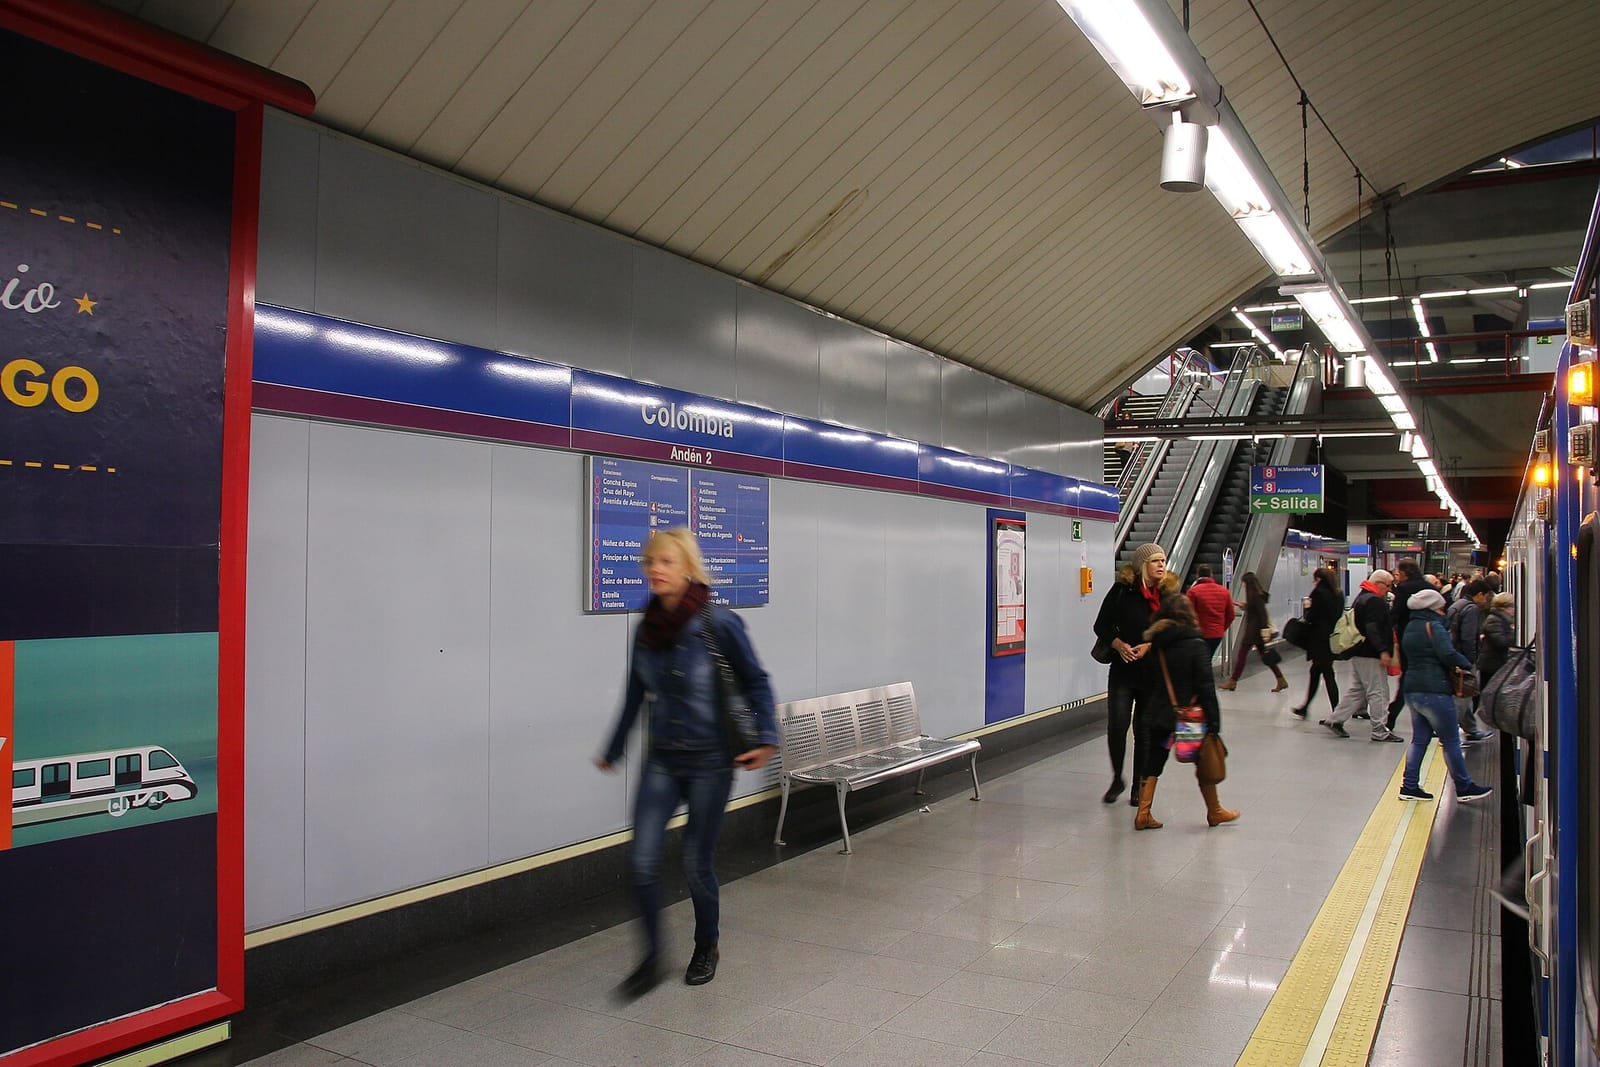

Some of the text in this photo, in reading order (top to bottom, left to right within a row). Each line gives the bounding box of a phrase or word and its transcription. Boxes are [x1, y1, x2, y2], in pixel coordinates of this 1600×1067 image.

[0, 358, 100, 413] GO
[641, 402, 734, 438] Colombia
[671, 446, 712, 465] Andén 2
[1266, 468, 1273, 478] 8
[603, 478, 637, 489] Concha Espina
[1266, 483, 1273, 492] 8
[603, 497, 622, 505] Avenida
[629, 499, 648, 507] América
[1270, 497, 1318, 509] Salida
[652, 503, 656, 512] 4
[625, 540, 641, 548] Balboa
[602, 553, 622, 562] Príncipe
[602, 591, 620, 599] Estrella
